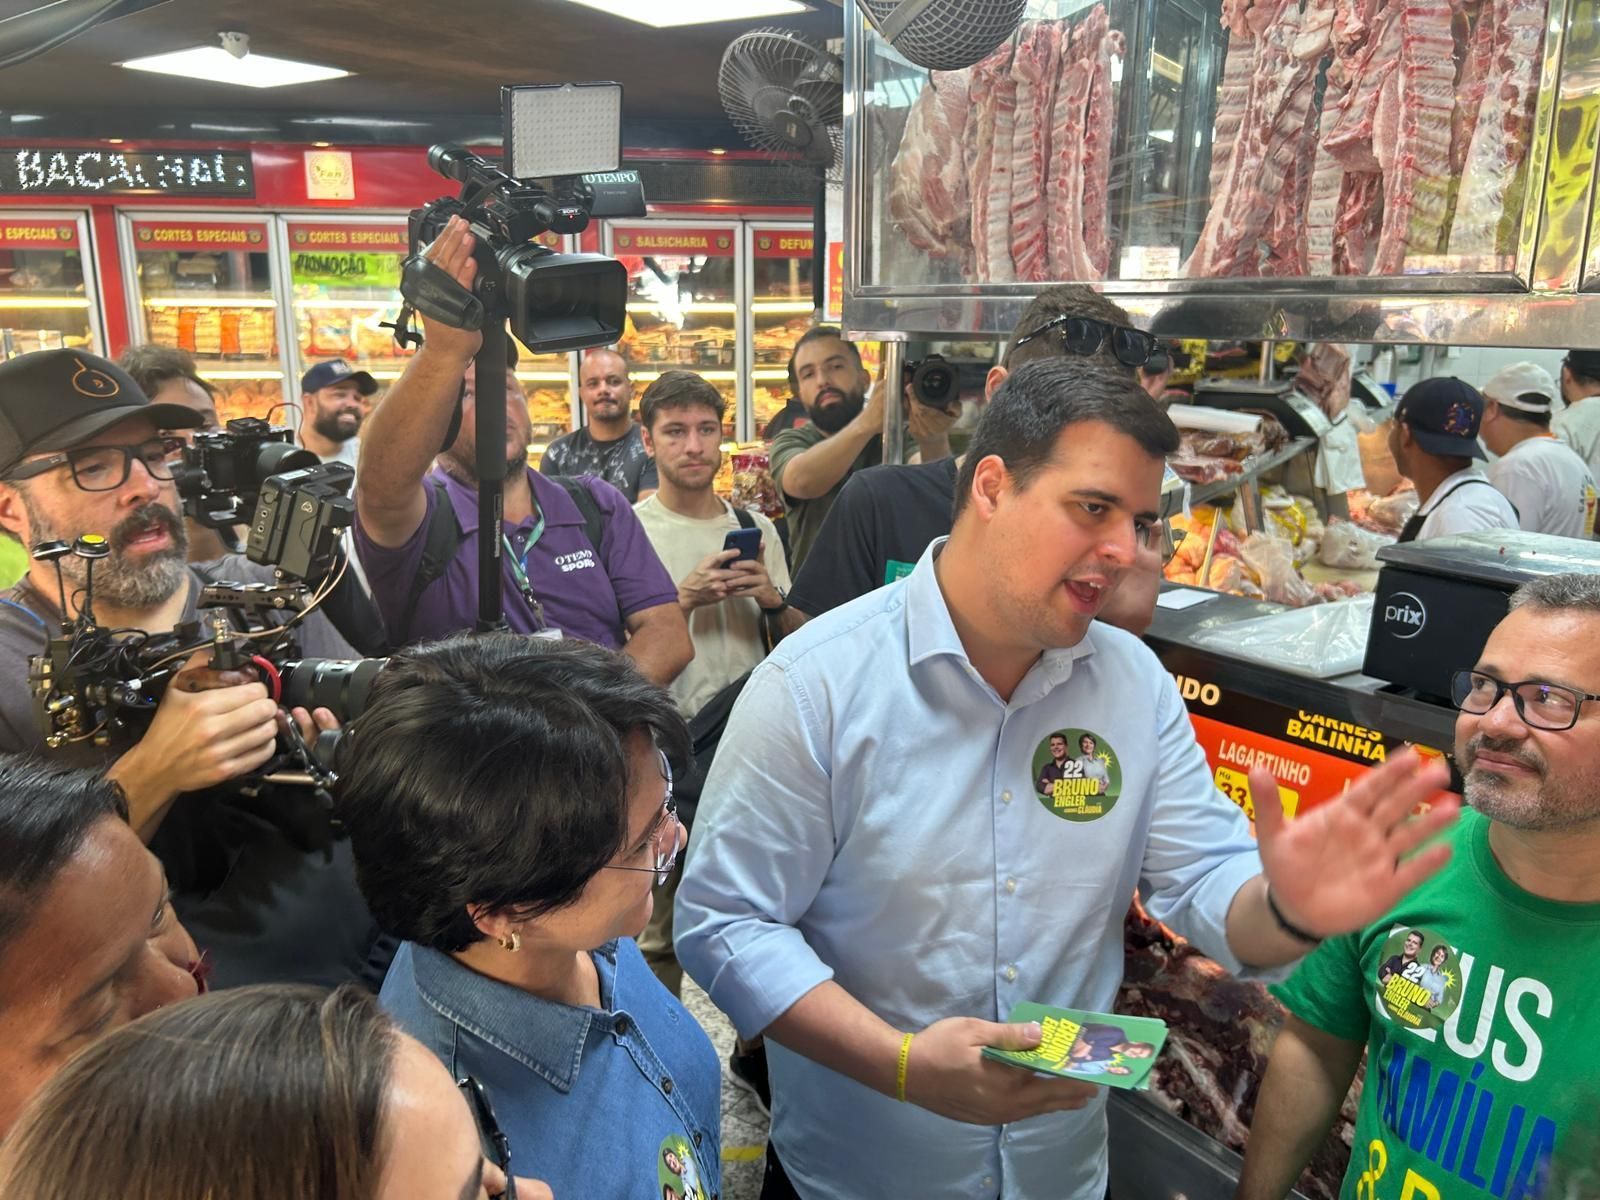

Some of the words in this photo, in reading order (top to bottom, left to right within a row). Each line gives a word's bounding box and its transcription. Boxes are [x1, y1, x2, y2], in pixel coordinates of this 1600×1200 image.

[5, 227, 57, 241] ESPECIAIS
[153, 230, 193, 242] CORTES
[196, 230, 247, 243] ESPECIAIS
[308, 231, 348, 244] CORTES
[351, 232, 400, 244] ESPECIAIS
[636, 235, 708, 248] SALSICHARIA
[1384, 604, 1422, 626] prix
[1286, 718, 1386, 763] BALINHA
[1063, 760, 1084, 778] 22
[1218, 738, 1311, 786] LAGARTINHO
[1052, 778, 1099, 797] BRUNO
[1054, 795, 1086, 808] ENGLER
[1401, 962, 1426, 984] 22
[1383, 988, 1411, 1011] ENGLER
[1386, 973, 1432, 1007] BRUNO
[1040, 1017, 1081, 1062] BRUNO
